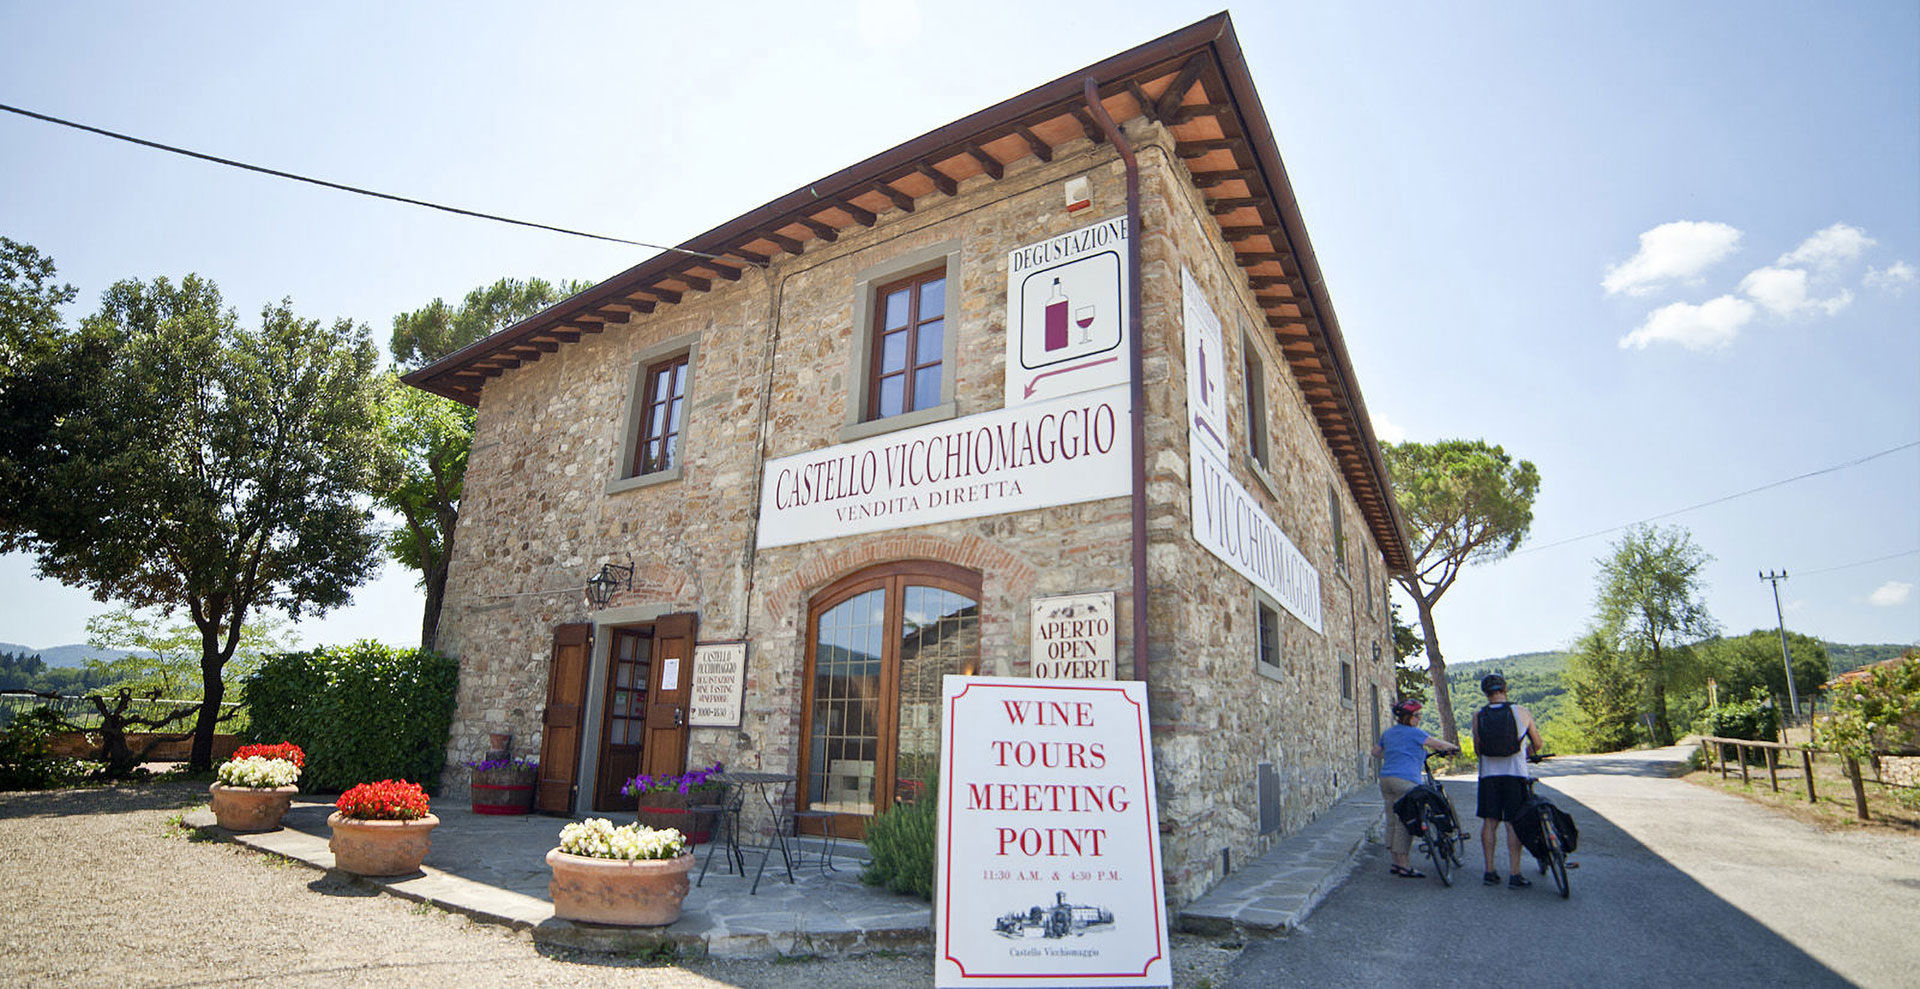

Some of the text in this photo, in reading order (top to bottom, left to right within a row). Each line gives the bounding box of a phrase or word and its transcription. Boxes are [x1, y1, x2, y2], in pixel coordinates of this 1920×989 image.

[1014, 218, 1129, 273] DEGUSTAZIONE
[775, 402, 1116, 511] CASTELLO VICCHIOMAGGIO
[836, 479, 1023, 523] VENDITA DIRETTA
[1200, 455, 1318, 626] VICCHIOMAGGIO
[1037, 618, 1109, 640] APERTO
[1048, 640, 1097, 659] OPEN
[1036, 660, 1110, 679] OUVERT
[1002, 699, 1094, 727] WINE
[991, 740, 1107, 769] TOURS
[966, 783, 1131, 813] MEETING
[995, 827, 1107, 857] POINT
[983, 870, 1123, 881] 11:30 A.M. & 4:30 P.M.
[1009, 947, 1042, 957] Castello
